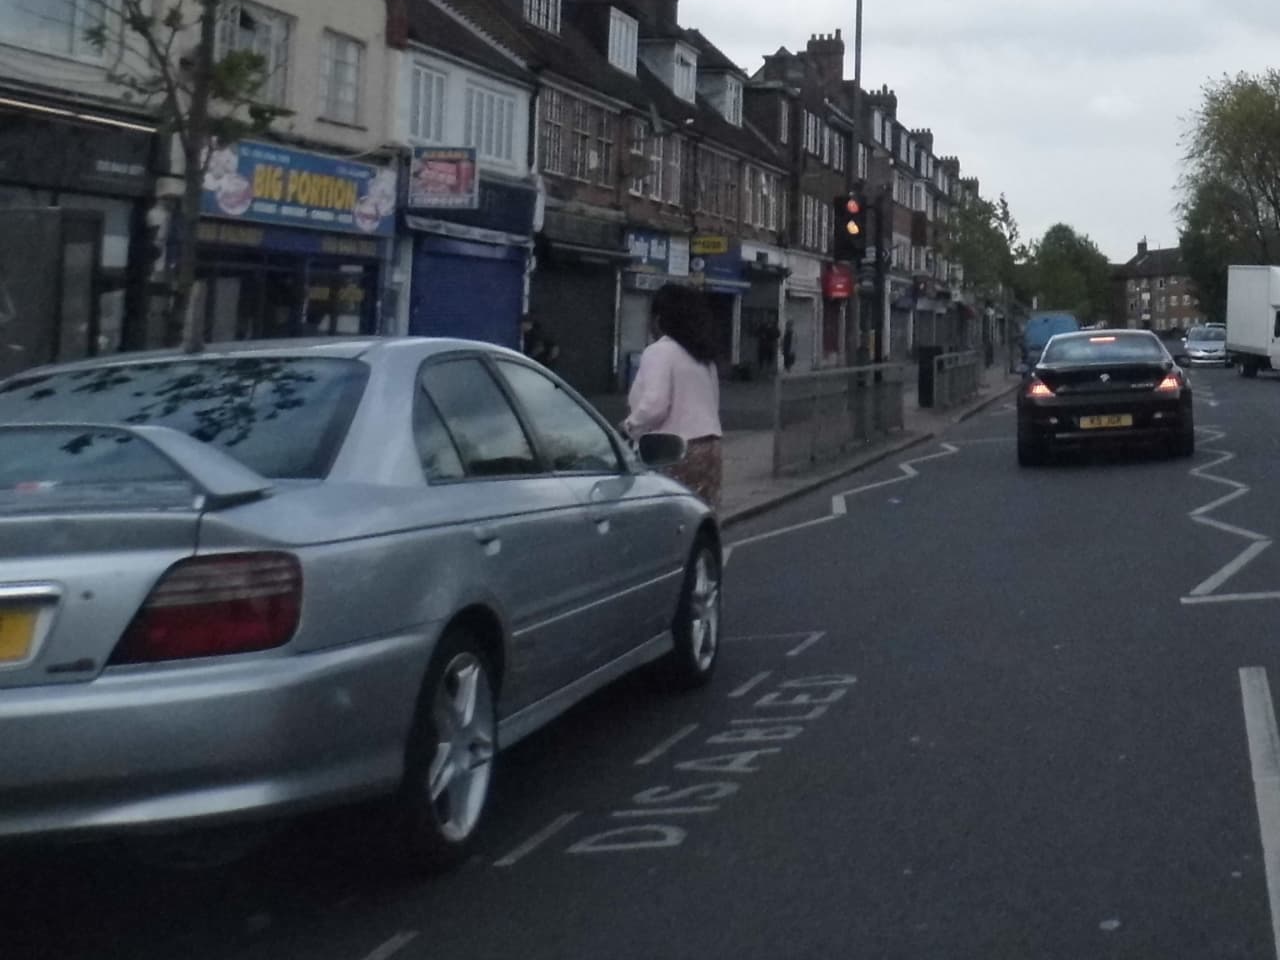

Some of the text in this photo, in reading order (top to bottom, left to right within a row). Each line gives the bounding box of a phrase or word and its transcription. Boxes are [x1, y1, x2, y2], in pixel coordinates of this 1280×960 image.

[252, 164, 359, 210] BIG PORTION
[566, 673, 858, 854] DISABLED
